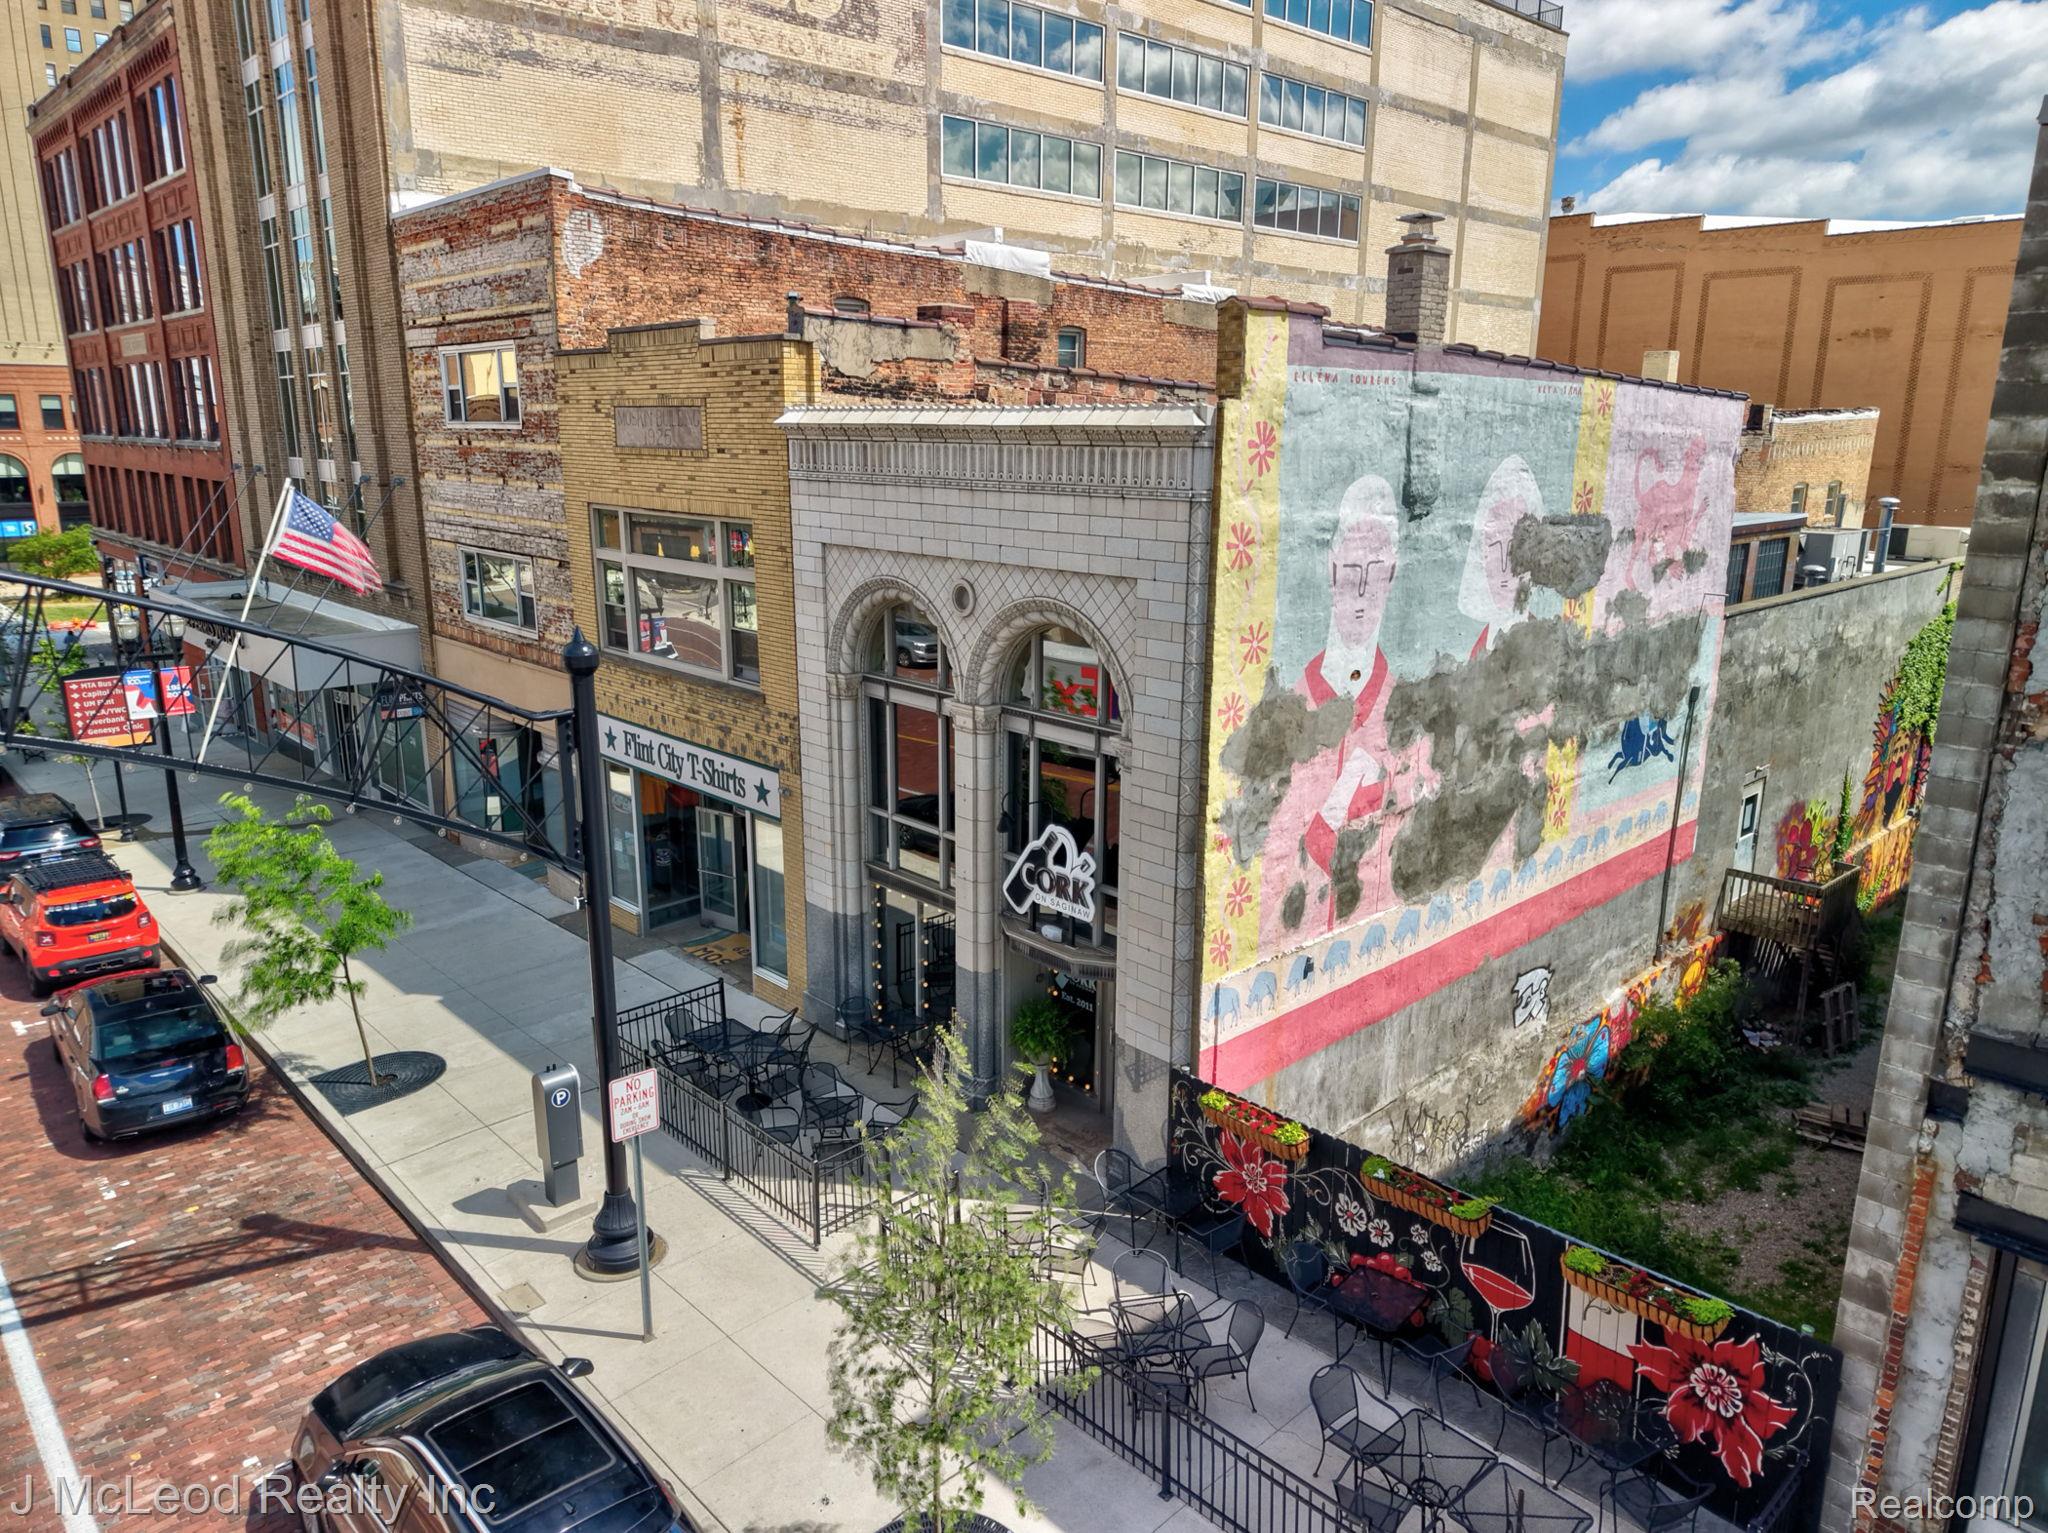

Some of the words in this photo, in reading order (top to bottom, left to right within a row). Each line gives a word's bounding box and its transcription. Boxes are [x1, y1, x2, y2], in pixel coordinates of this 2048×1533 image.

[80, 681, 96, 690] MTA
[97, 680, 112, 688] Bus
[82, 688, 111, 698] Capitol
[97, 698, 115, 707] Fnt
[86, 715, 126, 726] verbank
[87, 725, 120, 736] Genesys
[122, 723, 144, 733] Cnic
[622, 730, 656, 766] Flint
[657, 742, 685, 780] City
[686, 751, 747, 799] T-Shirts
[1021, 862, 1090, 909] CORK
[1035, 892, 1047, 904] ON
[1050, 899, 1091, 919] SAGINAW
[1076, 997, 1094, 1013] 2011
[626, 1078, 641, 1093] NO
[614, 1086, 654, 1109] PARKING
